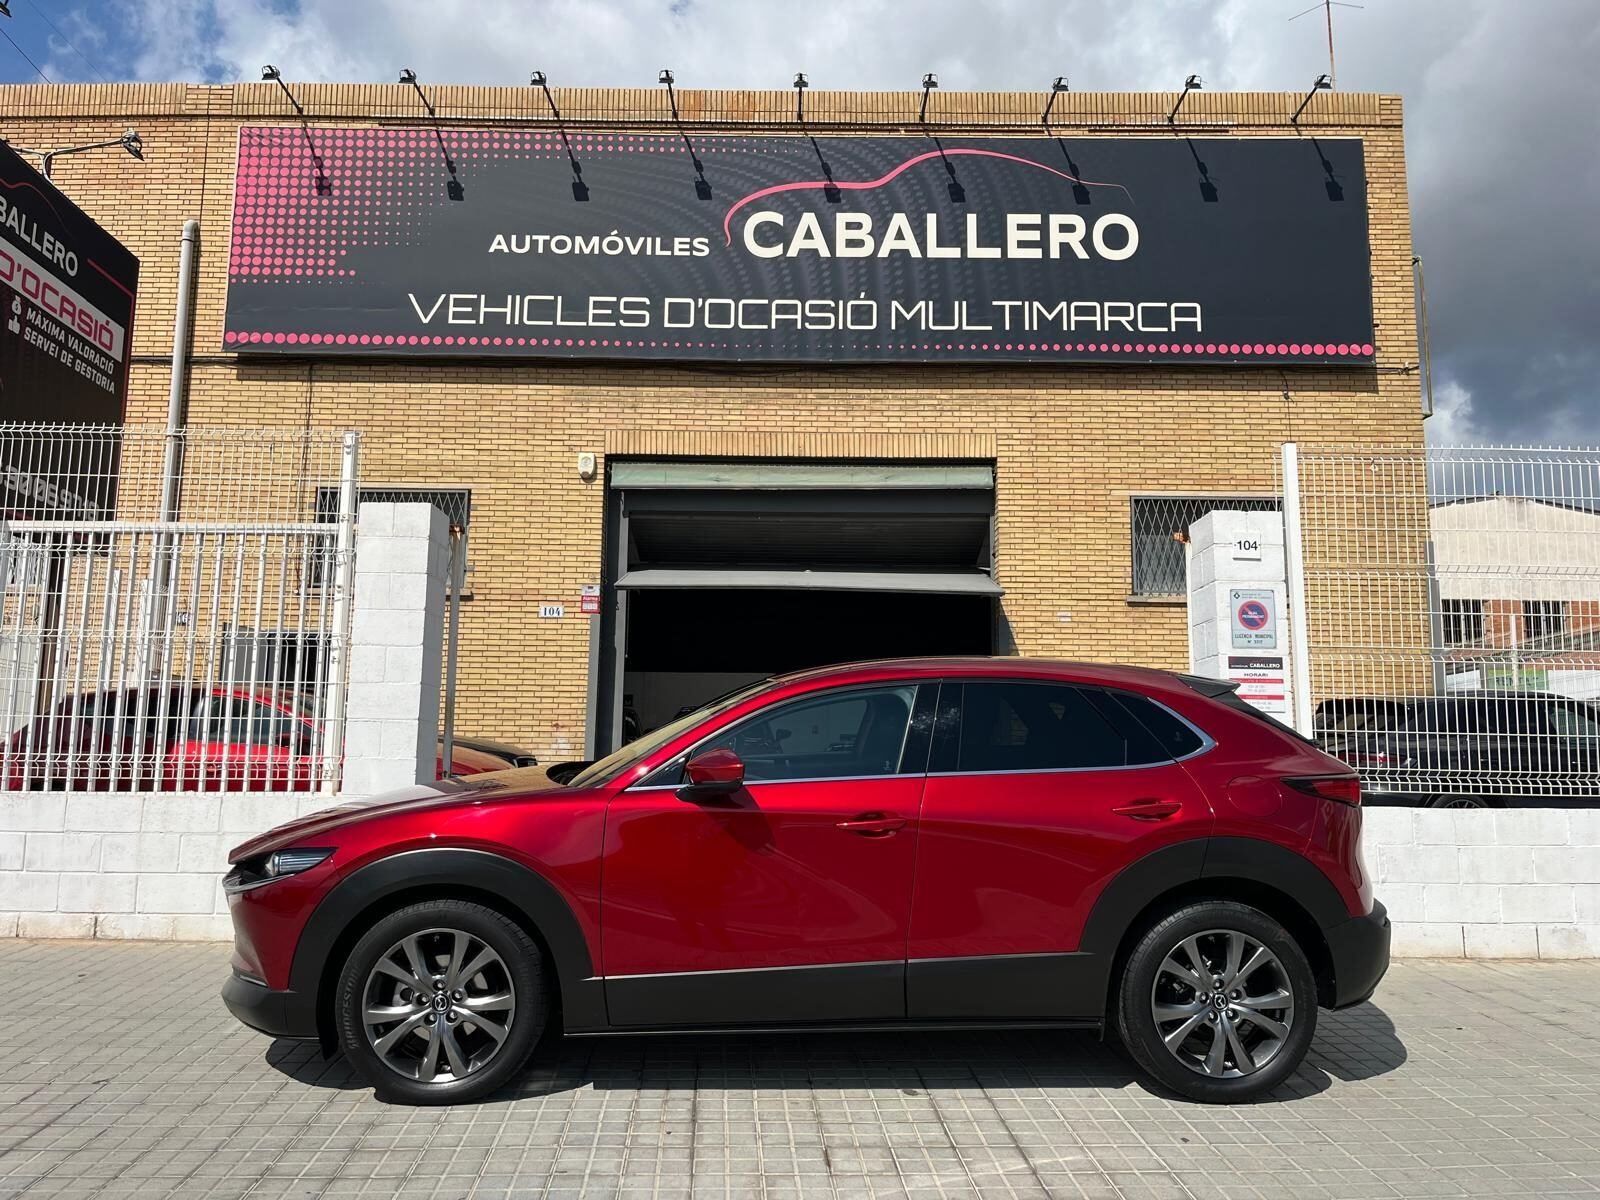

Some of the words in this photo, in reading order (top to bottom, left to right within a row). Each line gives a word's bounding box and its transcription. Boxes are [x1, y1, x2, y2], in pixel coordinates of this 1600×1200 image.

[488, 230, 710, 257] AUTOMÓVILES
[743, 210, 1139, 261] CABALLERO
[407, 293, 651, 328] VEHICLES
[663, 291, 878, 330] D'OCASIÓ
[891, 300, 1202, 332] MULTIMARCA
[24, 326, 59, 358] SERVEI
[60, 349, 74, 367] DE
[74, 358, 115, 394] GESTORIA
[68, 334, 114, 375] VALORACIÓ
[1236, 540, 1258, 551] 104
[544, 607, 560, 616] 104
